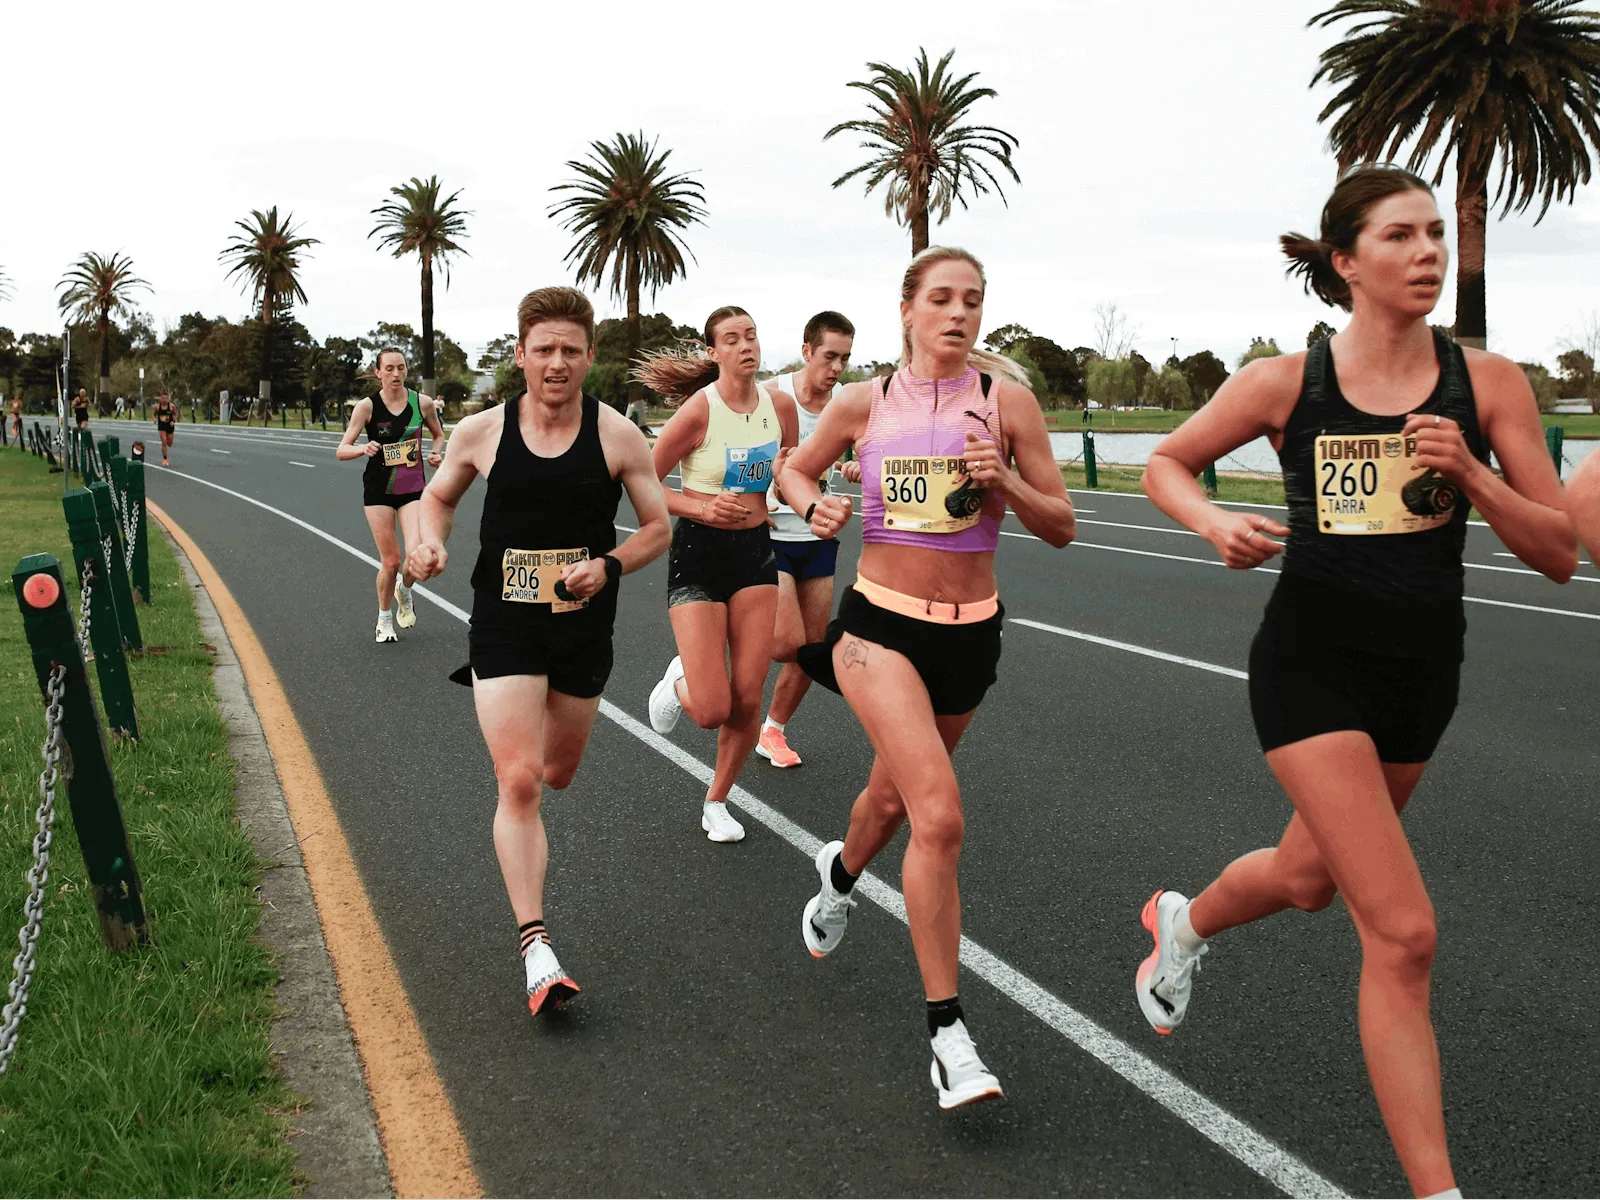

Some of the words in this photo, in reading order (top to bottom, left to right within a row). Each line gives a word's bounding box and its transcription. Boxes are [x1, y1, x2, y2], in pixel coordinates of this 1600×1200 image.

[386, 449, 401, 460] 308
[1320, 439, 1380, 459] 10KM
[738, 459, 772, 483] 7407
[885, 459, 929, 475] 10KM
[1322, 462, 1378, 496] 260
[885, 477, 927, 503] 360
[1328, 499, 1366, 514] TARRA
[1367, 521, 1384, 530] 260
[506, 566, 539, 589] 206
[511, 589, 538, 600] ANDREW
